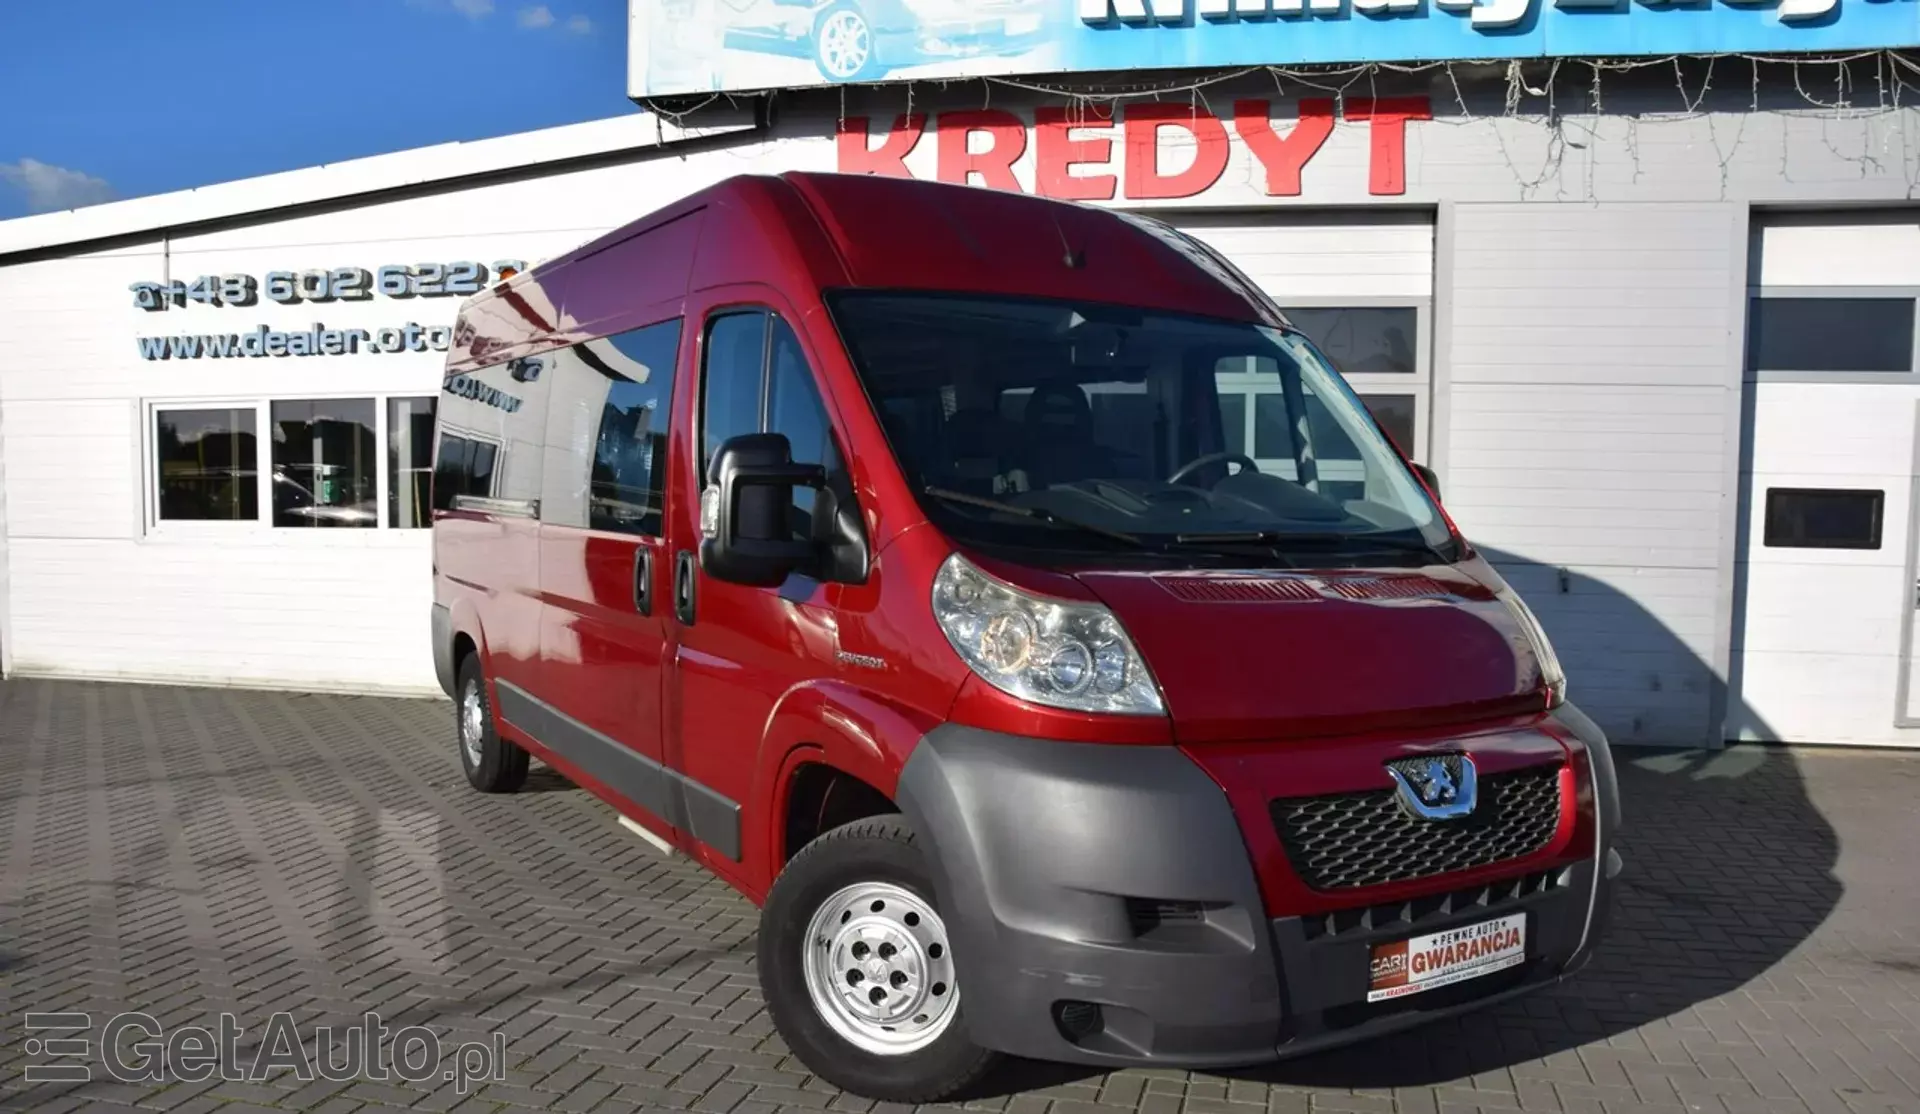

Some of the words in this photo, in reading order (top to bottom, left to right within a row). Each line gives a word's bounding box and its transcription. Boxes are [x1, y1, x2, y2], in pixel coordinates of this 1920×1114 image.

[837, 96, 1432, 200] KREDYT
[265, 266, 372, 304] 602
[377, 260, 489, 299] 622
[1411, 927, 1521, 975] GWARANCJA
[1440, 928, 1474, 946] PEWNE
[1476, 920, 1500, 936] AUTO
